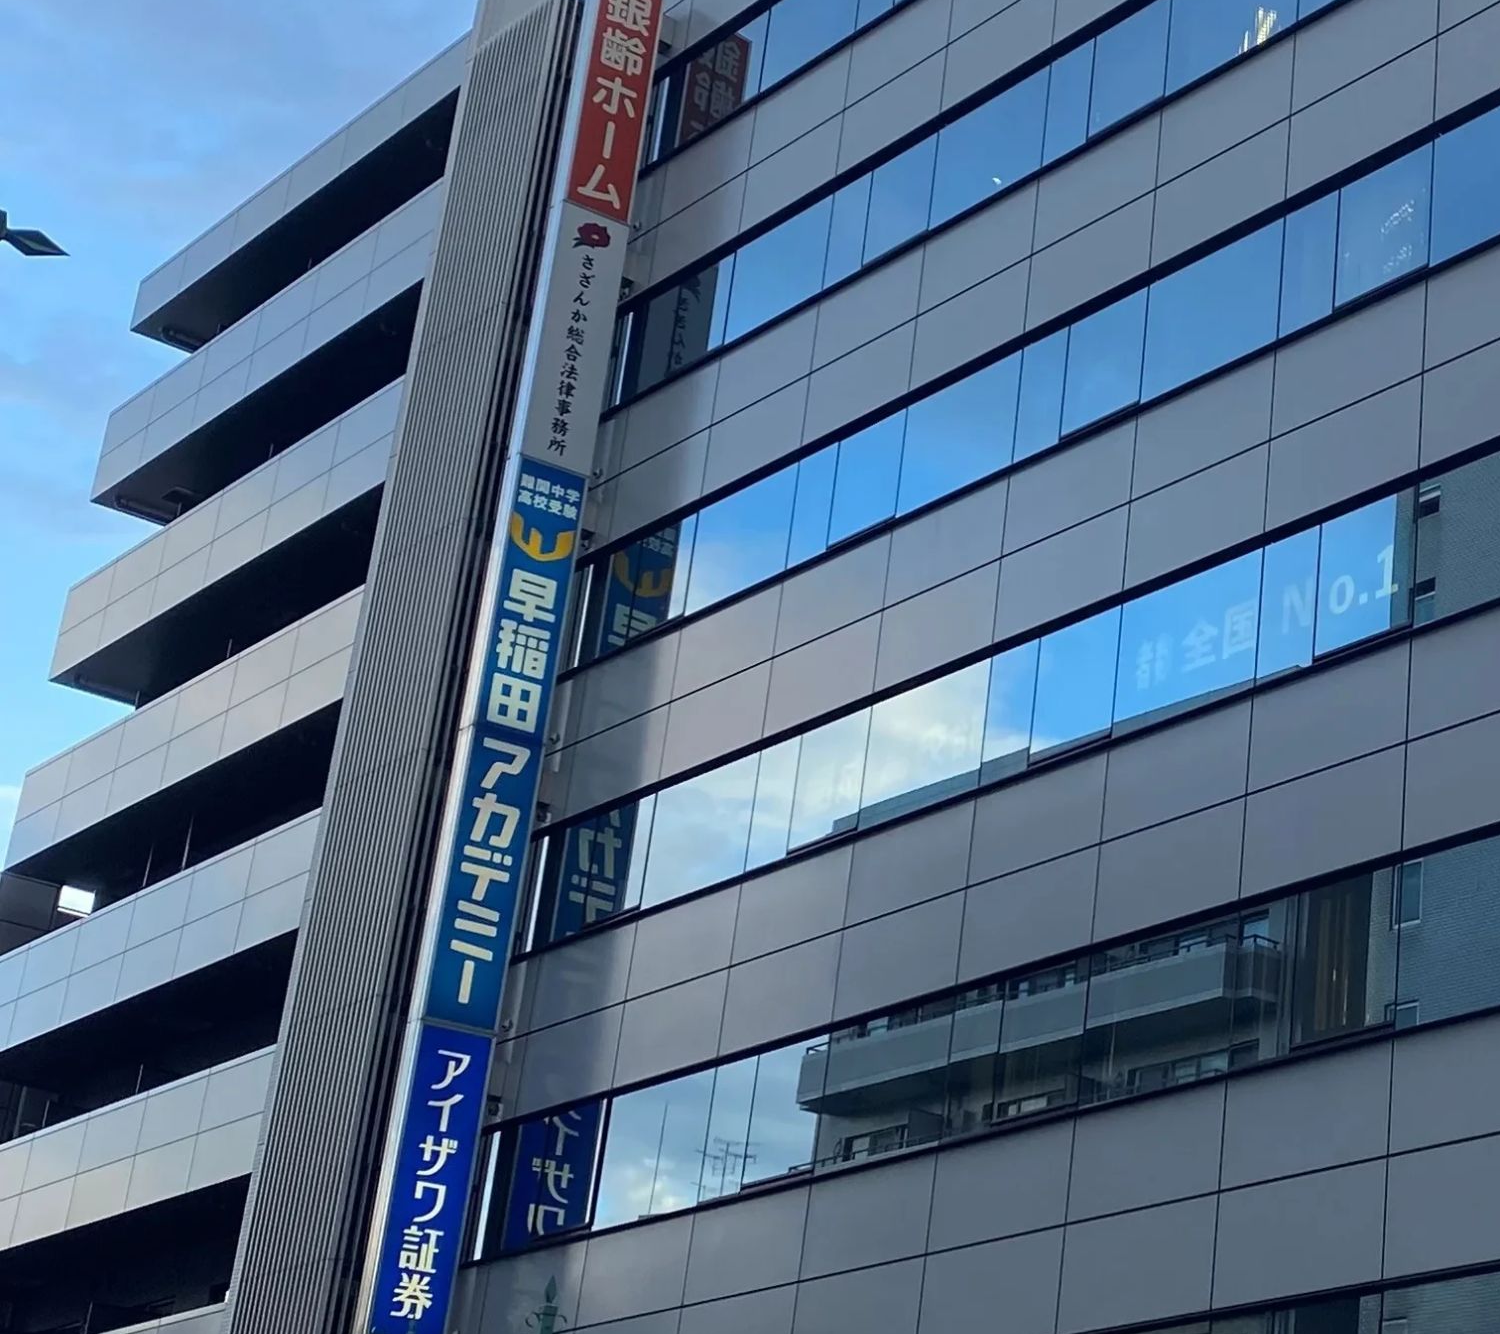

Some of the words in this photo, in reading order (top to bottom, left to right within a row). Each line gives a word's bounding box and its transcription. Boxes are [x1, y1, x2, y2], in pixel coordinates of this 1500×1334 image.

[546, 252, 595, 457] さざんか総合法律事務所
[517, 489, 578, 521] 高校受験
[520, 473, 580, 504] 難関中学
[450, 567, 557, 1005] 早稲田アカデミー
[390, 1048, 470, 1320] アイザワ証券
